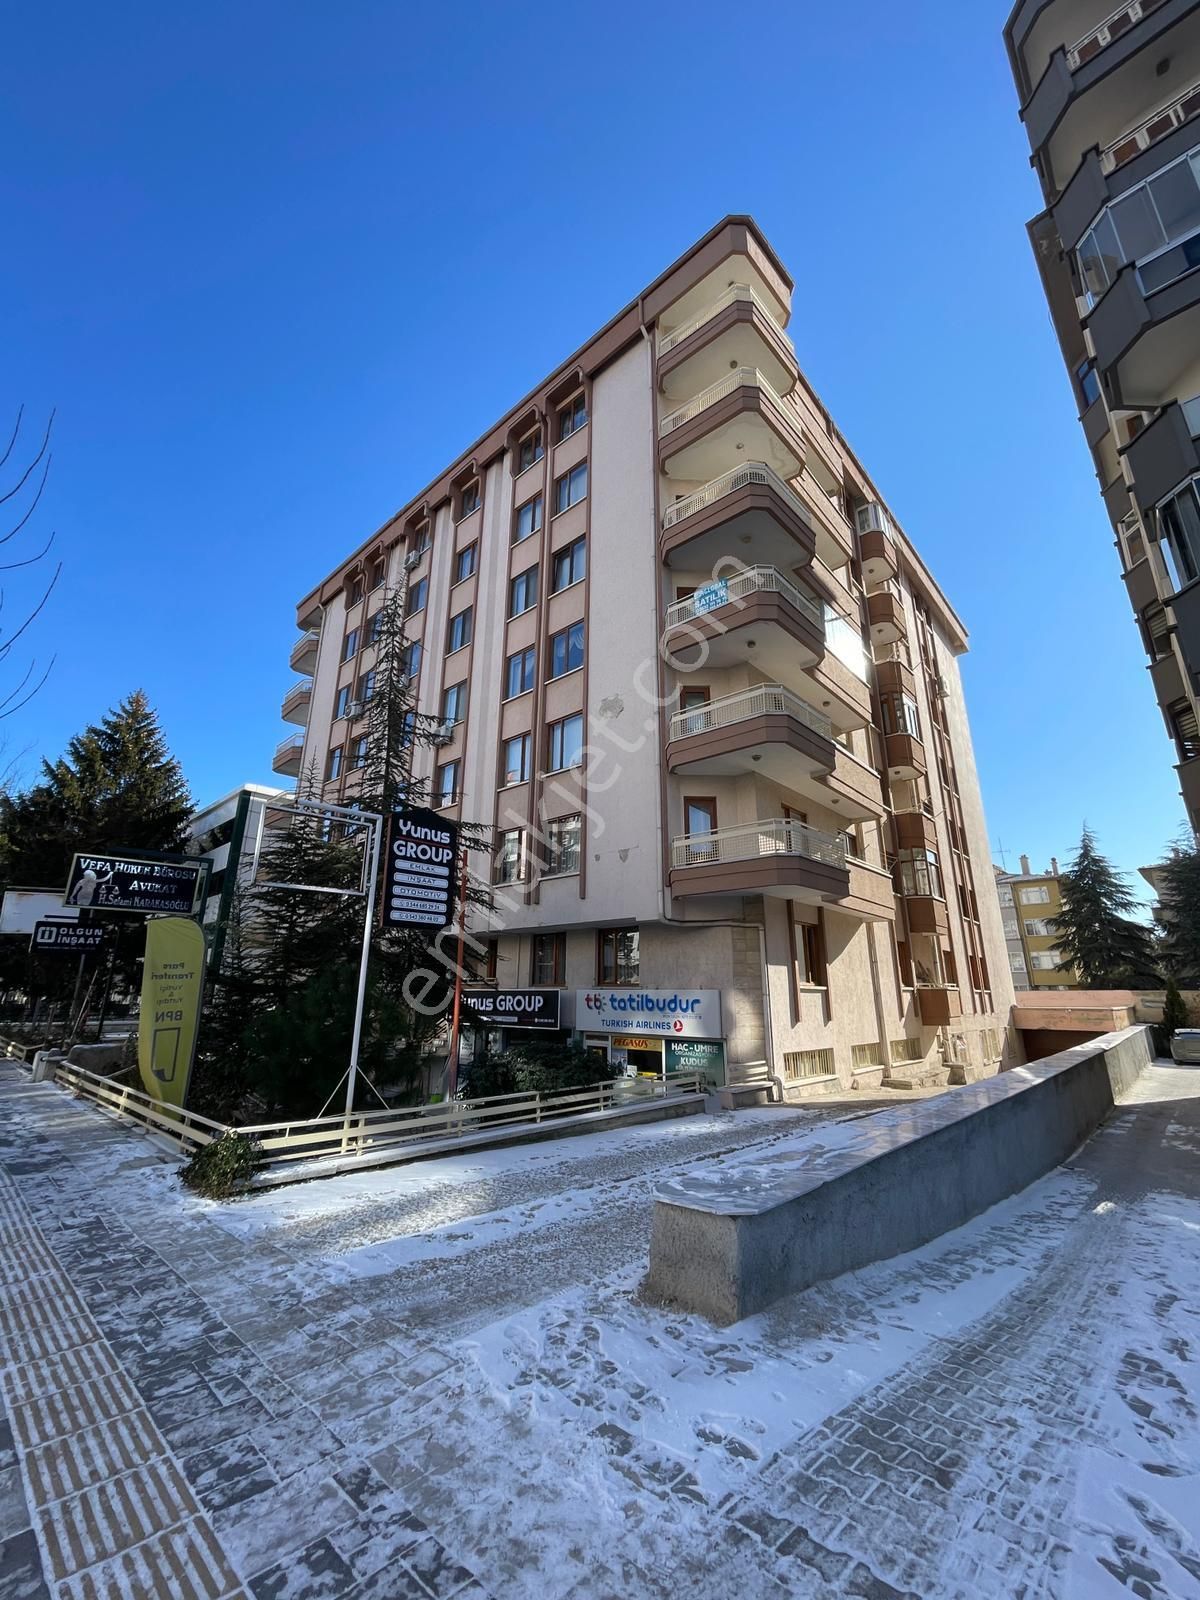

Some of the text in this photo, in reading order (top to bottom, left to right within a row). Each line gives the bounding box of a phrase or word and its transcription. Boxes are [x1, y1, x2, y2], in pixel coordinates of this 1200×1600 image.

[399, 819, 451, 844] Yunus
[393, 840, 453, 863] GROUP
[80, 858, 196, 880] VEFA HUKUK BÜROSU
[409, 863, 435, 872] EMLAK
[129, 880, 178, 894] AVUKAT
[60, 927, 103, 936] OLGUN
[57, 935, 101, 945] İNŞAAT
[496, 995, 544, 1012] GROUP
[609, 993, 701, 1013] tatilbudur
[601, 1019, 672, 1030] TURKISH AIRLINES
[613, 1037, 649, 1049] PEGASUS
[671, 1042, 689, 1051] HAC
[694, 1044, 719, 1054] UMRE
